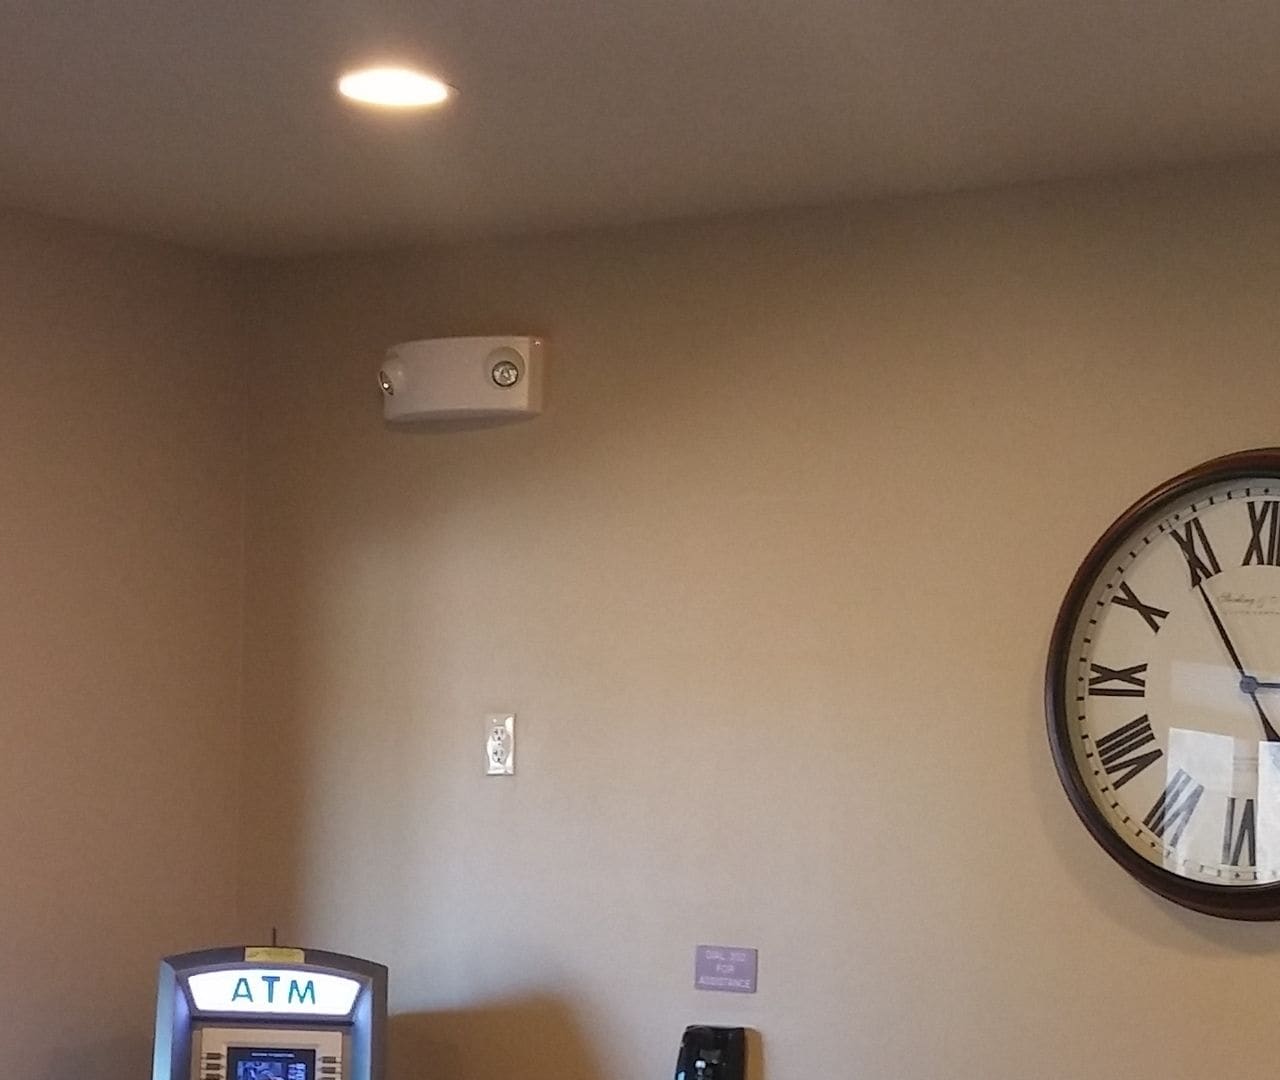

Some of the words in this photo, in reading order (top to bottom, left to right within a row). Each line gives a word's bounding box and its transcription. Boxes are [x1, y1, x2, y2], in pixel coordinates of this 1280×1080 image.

[1169, 516, 1222, 581] XI
[1111, 581, 1170, 633] X
[1088, 663, 1148, 698] IX
[1095, 714, 1165, 790] VIII
[1221, 796, 1257, 867] VI
[231, 975, 317, 1005] ATM
